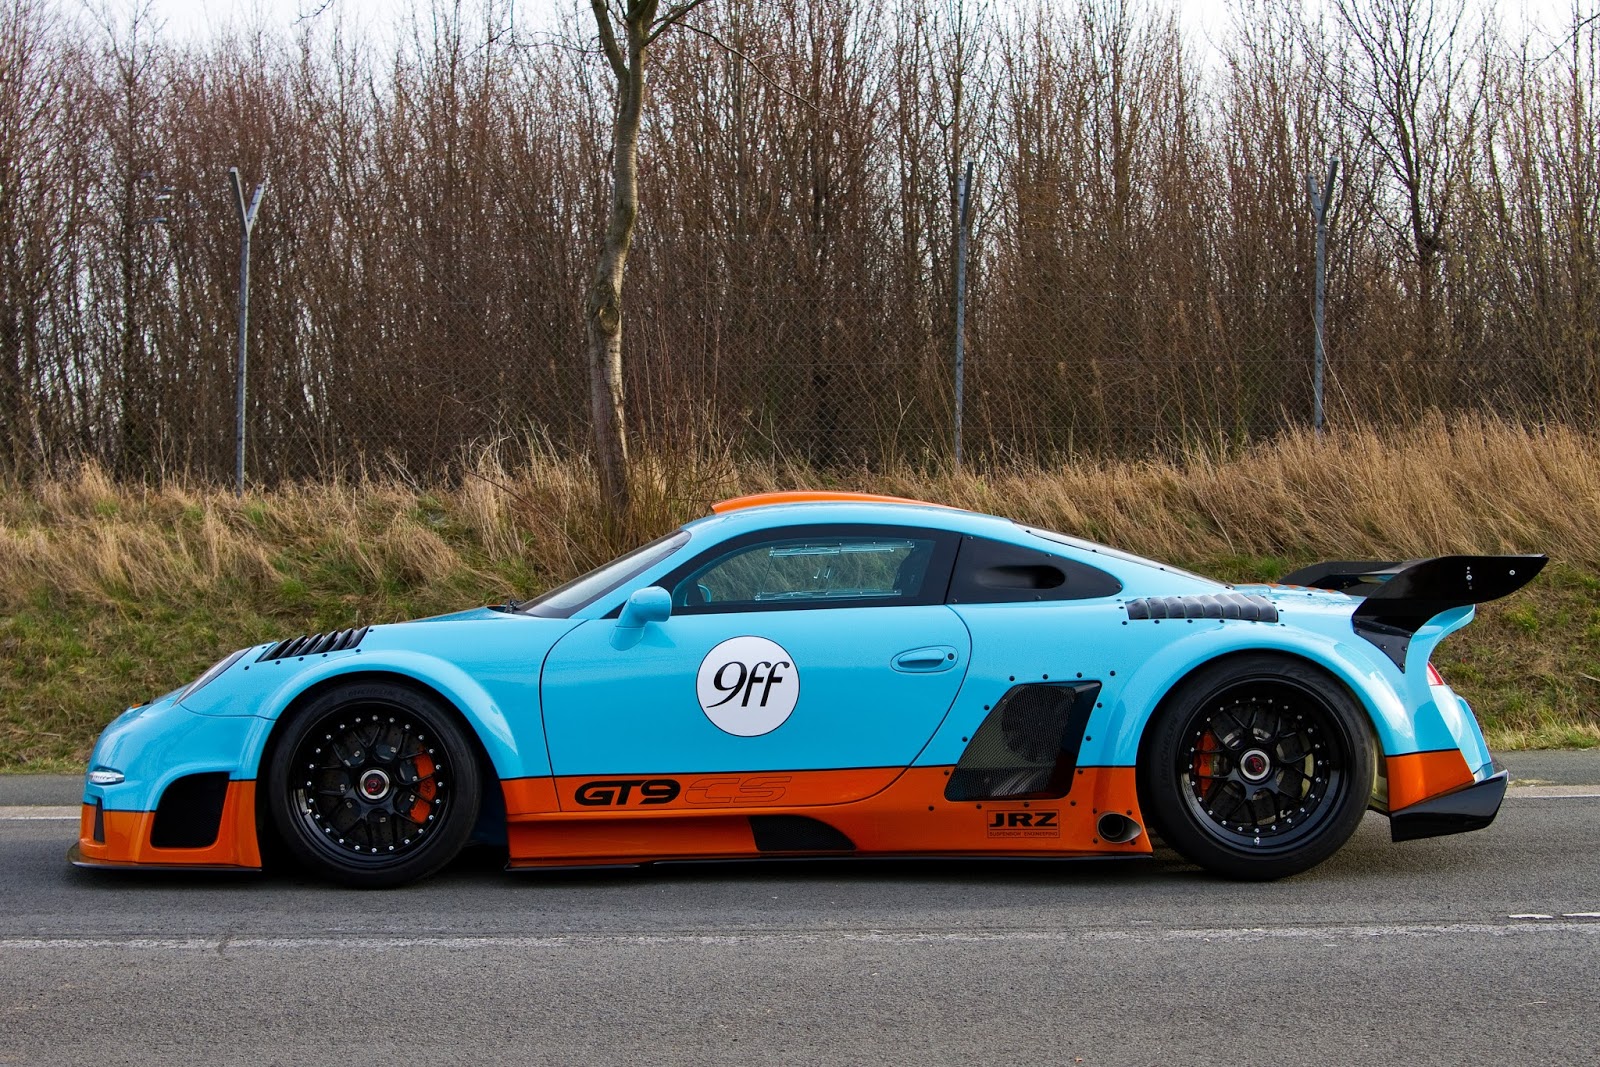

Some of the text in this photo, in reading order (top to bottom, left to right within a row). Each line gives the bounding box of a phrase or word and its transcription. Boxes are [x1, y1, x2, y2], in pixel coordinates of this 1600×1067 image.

[706, 661, 790, 708] 9ff
[574, 776, 792, 806] GT9 CS
[989, 812, 1058, 827] JRZ
